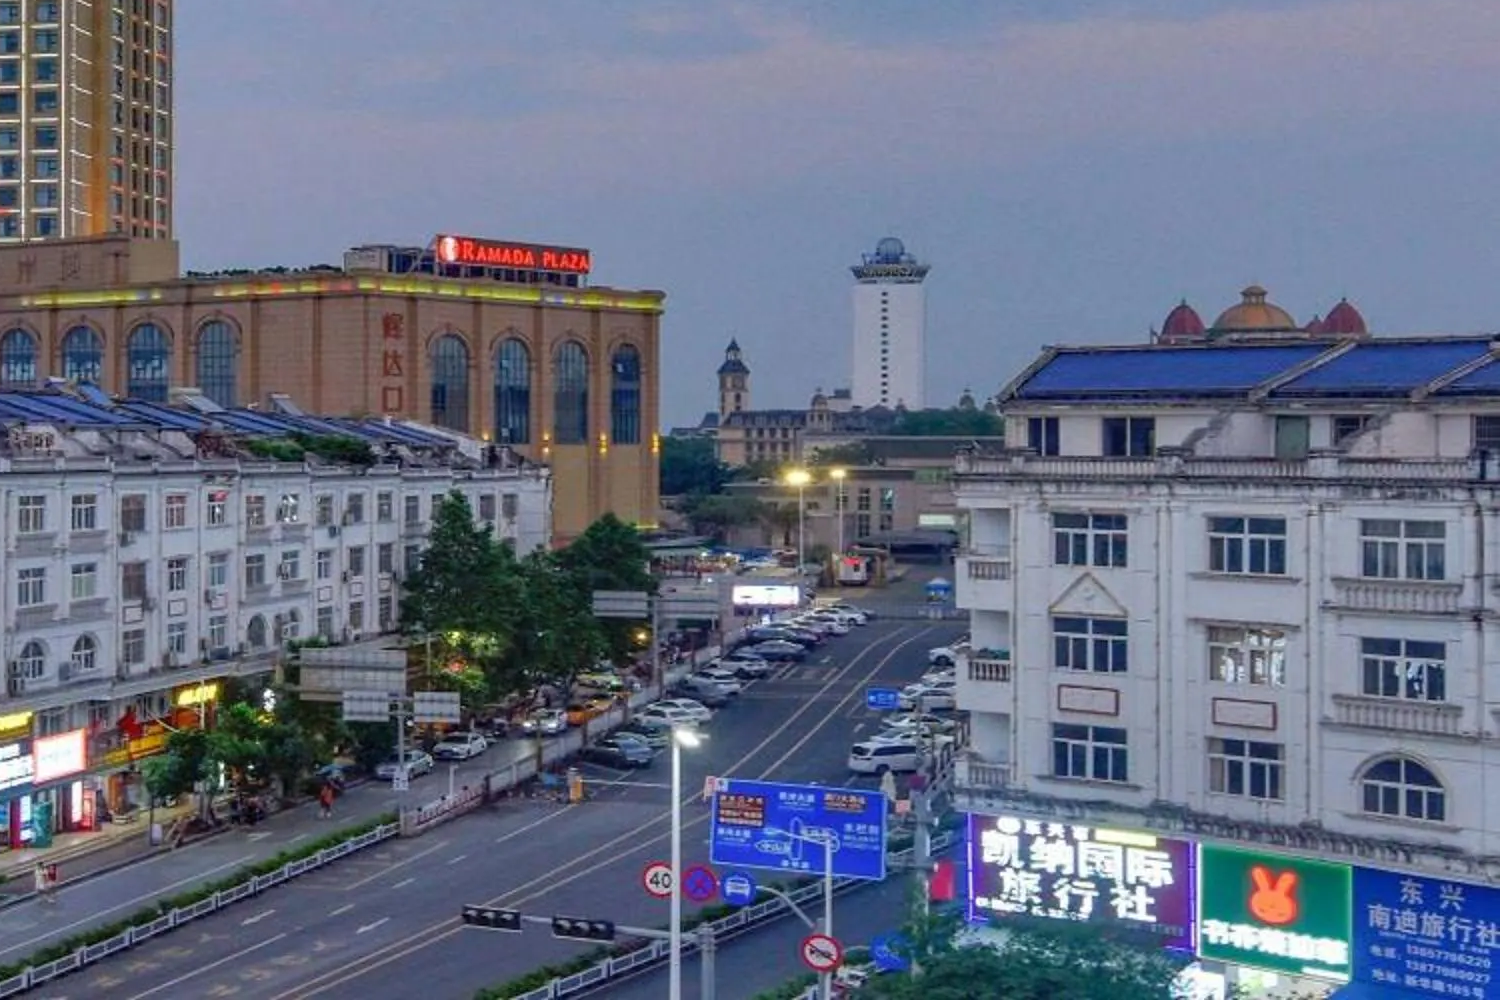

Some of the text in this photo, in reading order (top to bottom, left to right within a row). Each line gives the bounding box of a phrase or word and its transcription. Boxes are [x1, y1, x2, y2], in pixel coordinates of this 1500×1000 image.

[462, 241, 588, 270] RAMADA PLAZA
[649, 872, 672, 889] 40
[1000, 868, 1156, 922] 旅行社
[1400, 879, 1464, 911] 东兴
